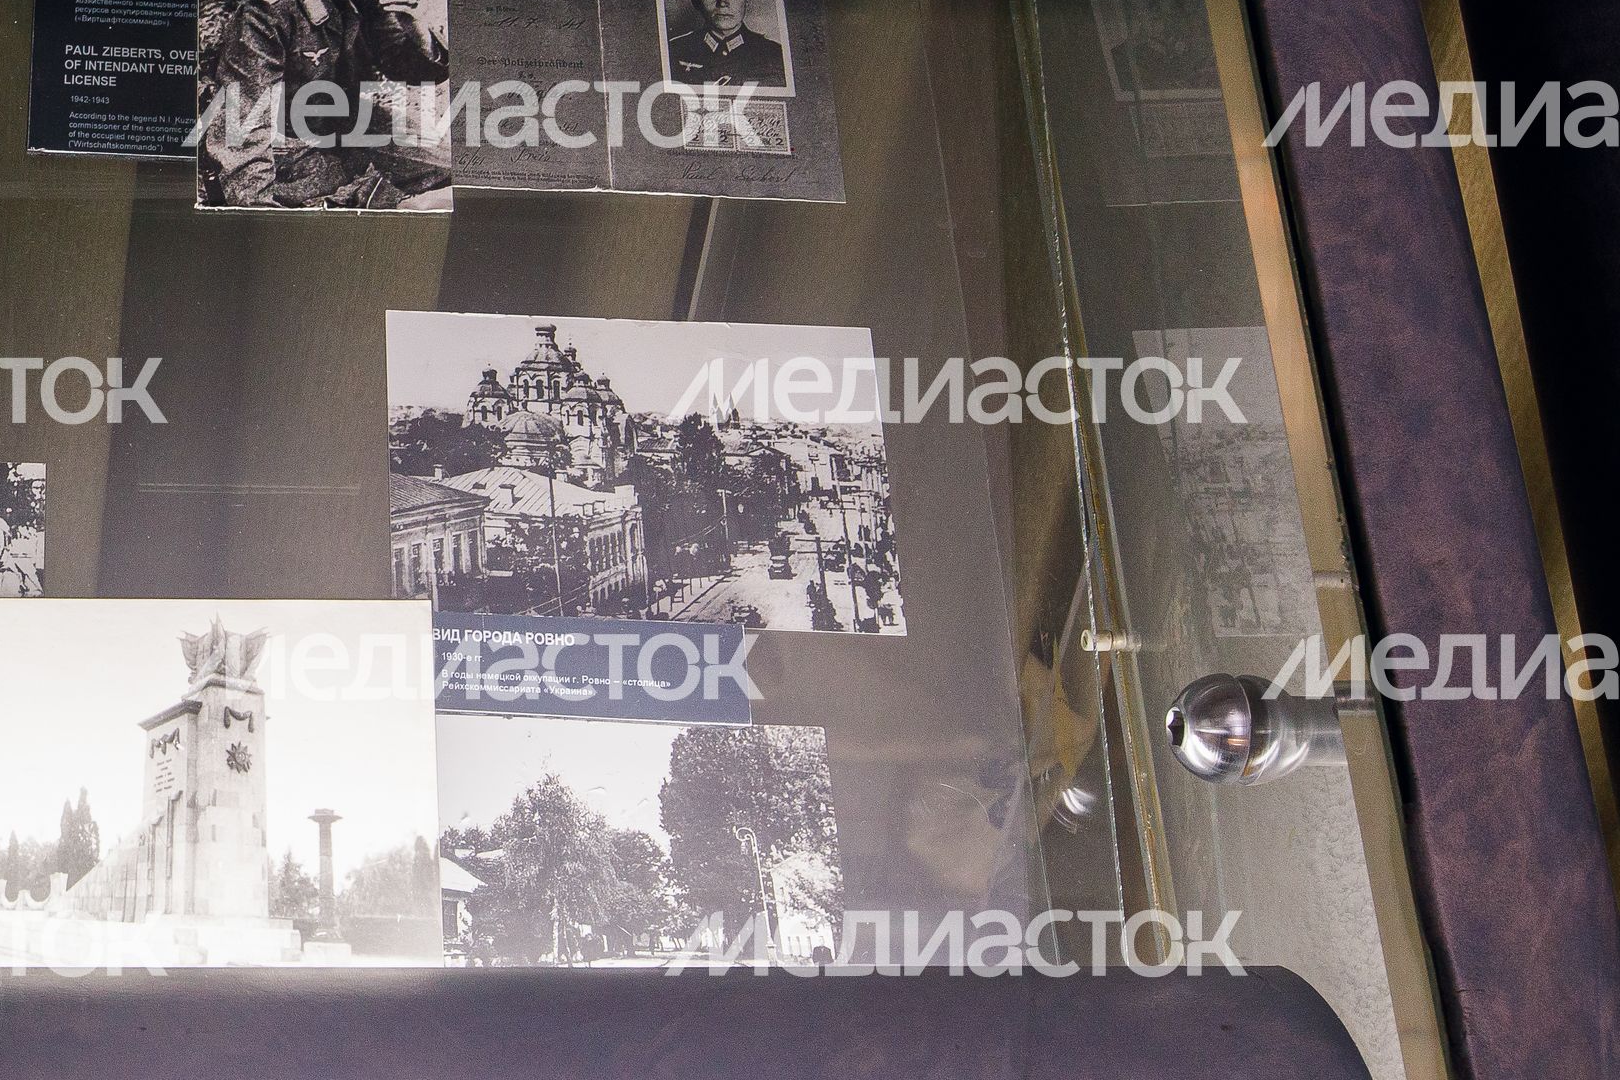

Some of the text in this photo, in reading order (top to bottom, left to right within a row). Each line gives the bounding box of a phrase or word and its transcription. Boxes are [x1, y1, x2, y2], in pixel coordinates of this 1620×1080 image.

[66, 45, 98, 56] PAUL
[102, 46, 164, 60] ZIEBERTS,
[65, 60, 81, 70] OF
[85, 61, 155, 73] INTENDANT
[64, 75, 117, 86] LICENSE
[70, 96, 109, 104] 1942-1943
[464, 629, 522, 644] ГОРОДА
[525, 632, 575, 646] РОВНО
